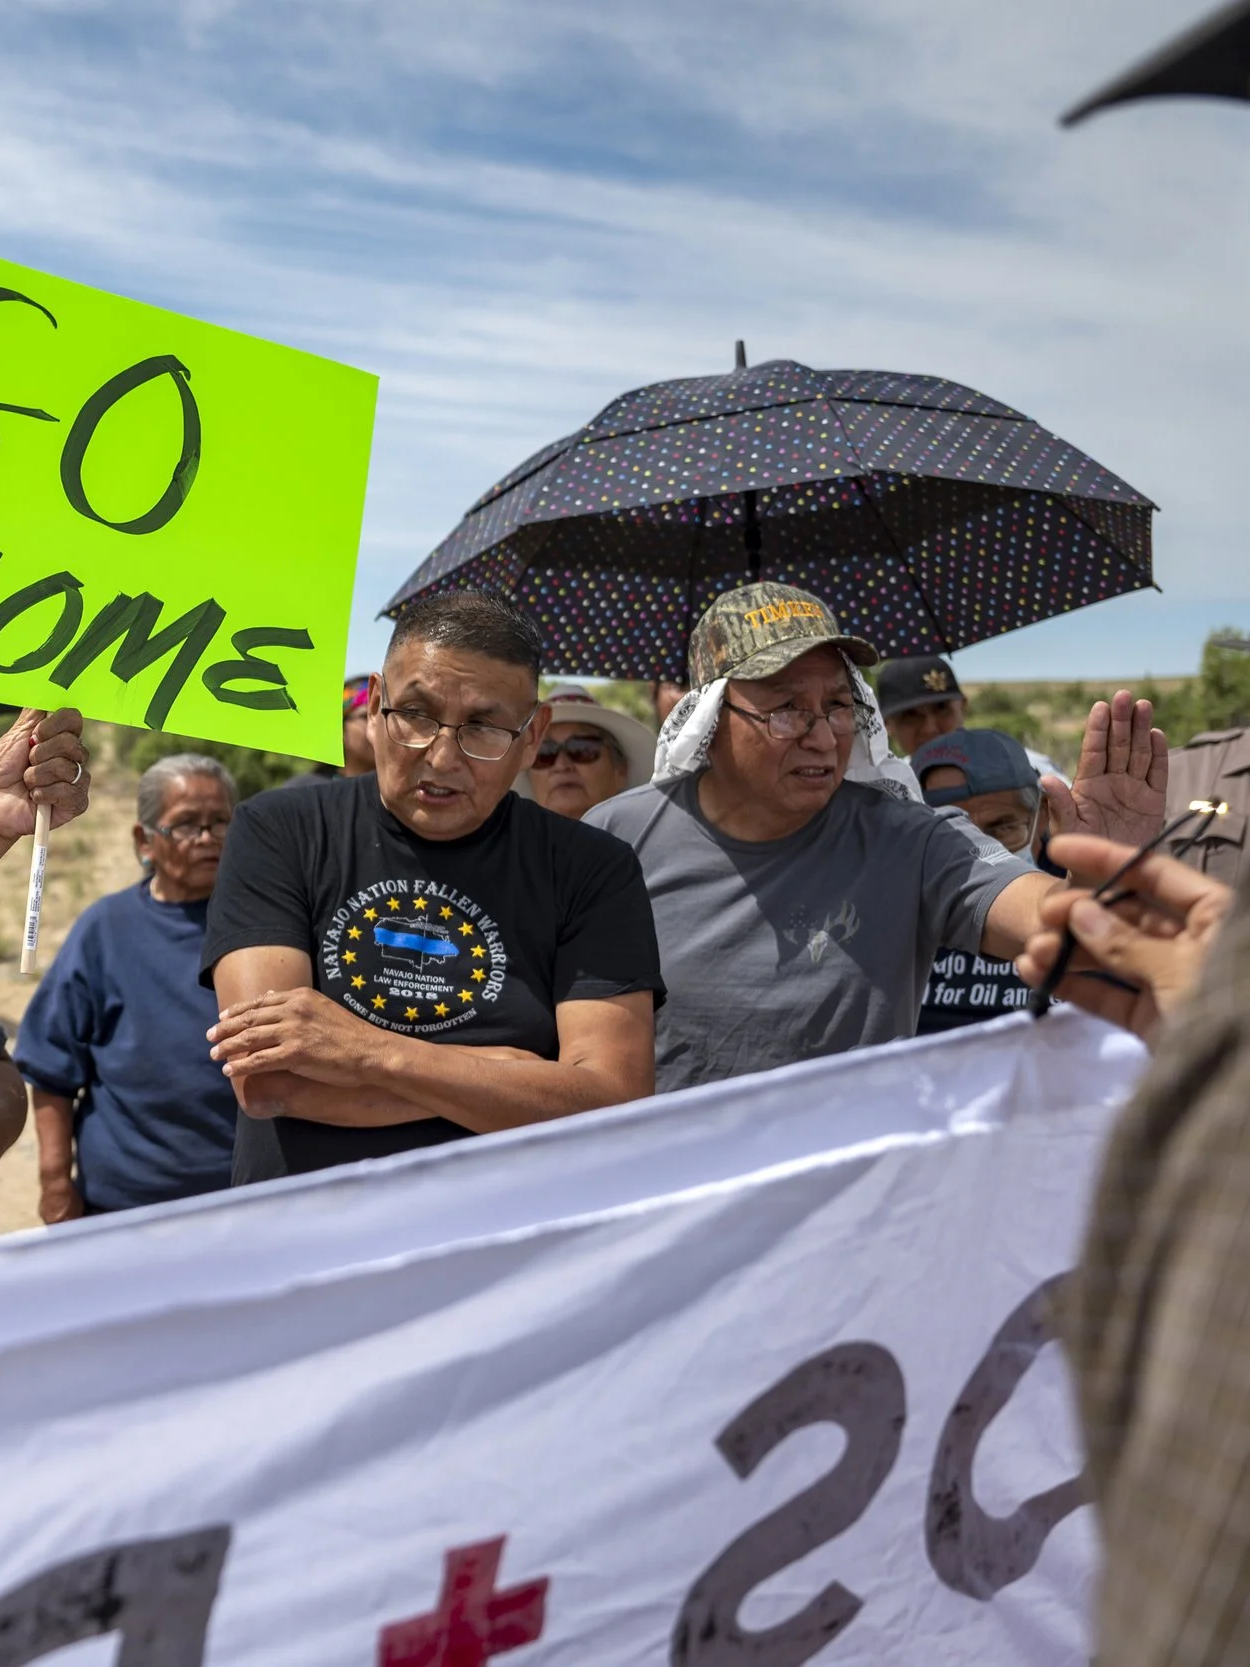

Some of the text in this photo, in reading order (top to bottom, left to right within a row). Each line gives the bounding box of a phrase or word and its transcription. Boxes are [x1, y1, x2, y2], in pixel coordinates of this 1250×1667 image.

[323, 880, 507, 1002] NAVAJO NATION FALLEN WARRIORS
[383, 968, 445, 984] NAVAJO NATION
[933, 951, 965, 980] ajo
[373, 975, 454, 992] LAW ENFORCEMENT
[389, 987, 438, 1000] 2018
[934, 982, 966, 1005] for
[969, 982, 998, 1006] Oil
[343, 993, 478, 1032] GONE BUT NOT FORGOTTEN
